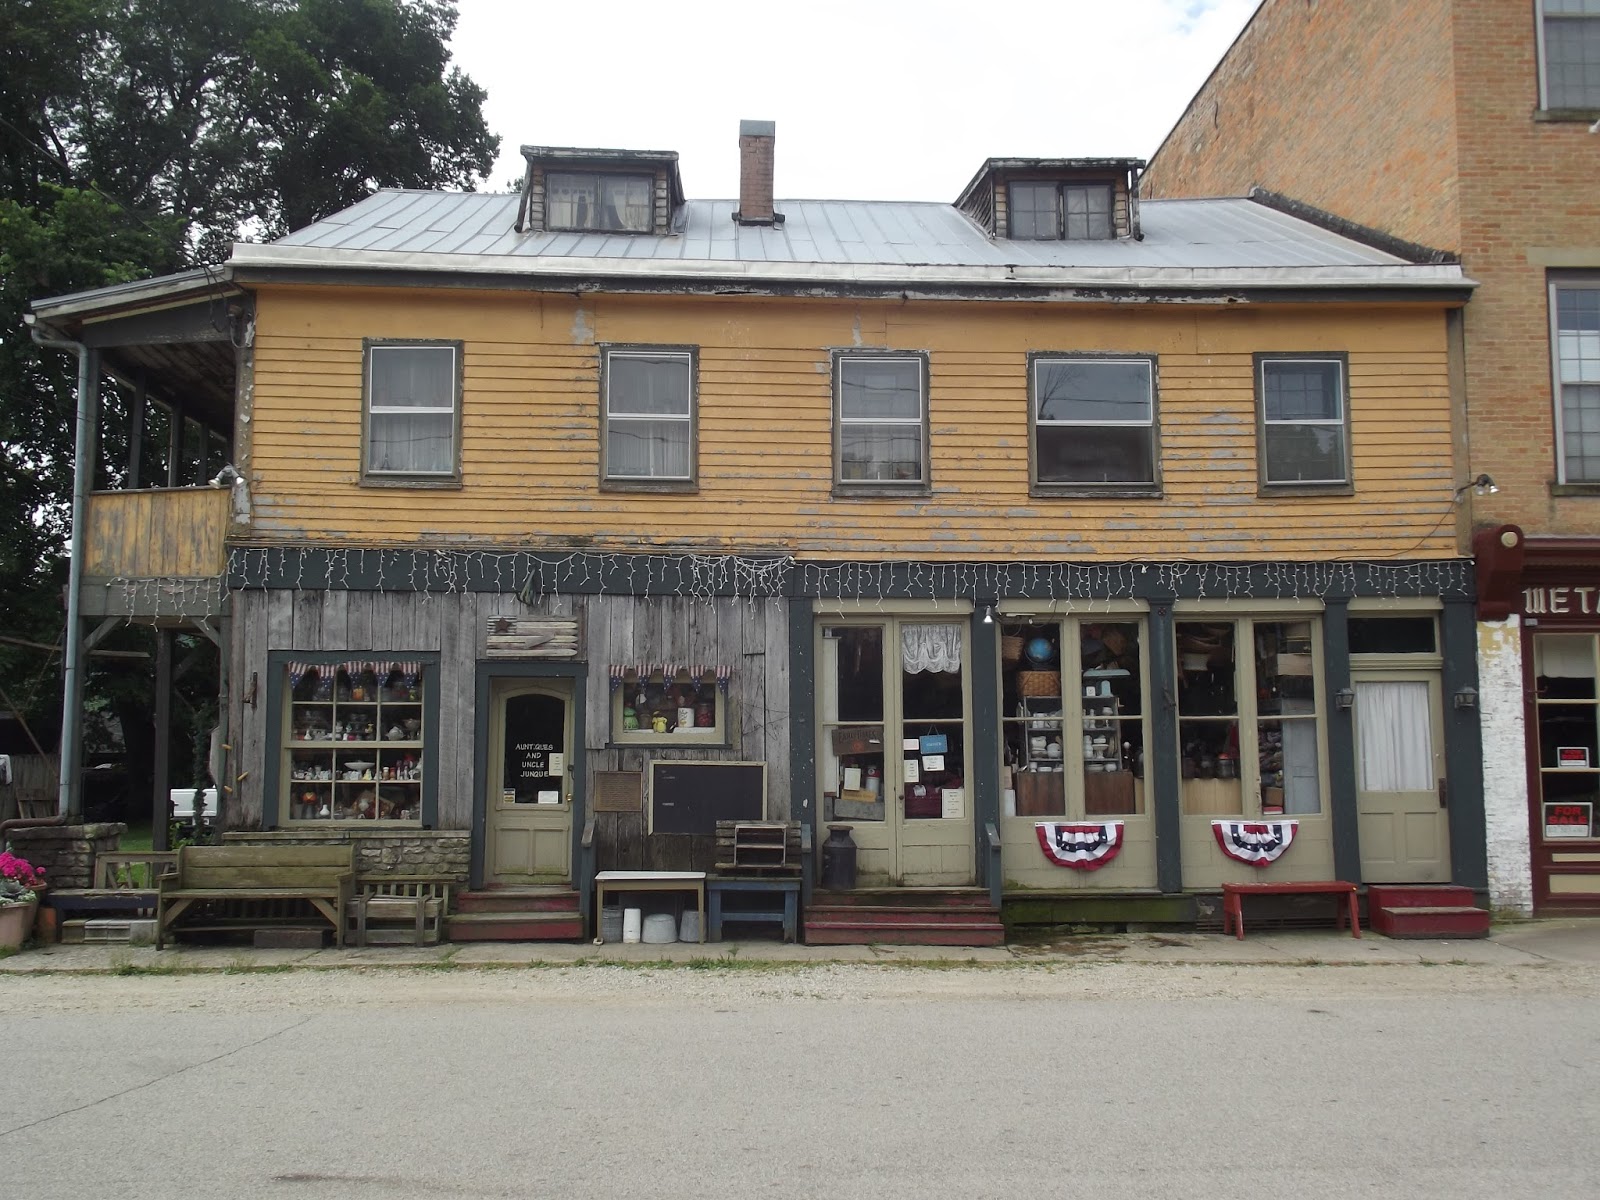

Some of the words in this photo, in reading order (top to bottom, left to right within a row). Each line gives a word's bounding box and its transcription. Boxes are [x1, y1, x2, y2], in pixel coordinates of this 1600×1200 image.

[520, 770, 549, 778] JUNQUE
[1554, 806, 1582, 815] FOR
[1548, 815, 1588, 825] SALE
